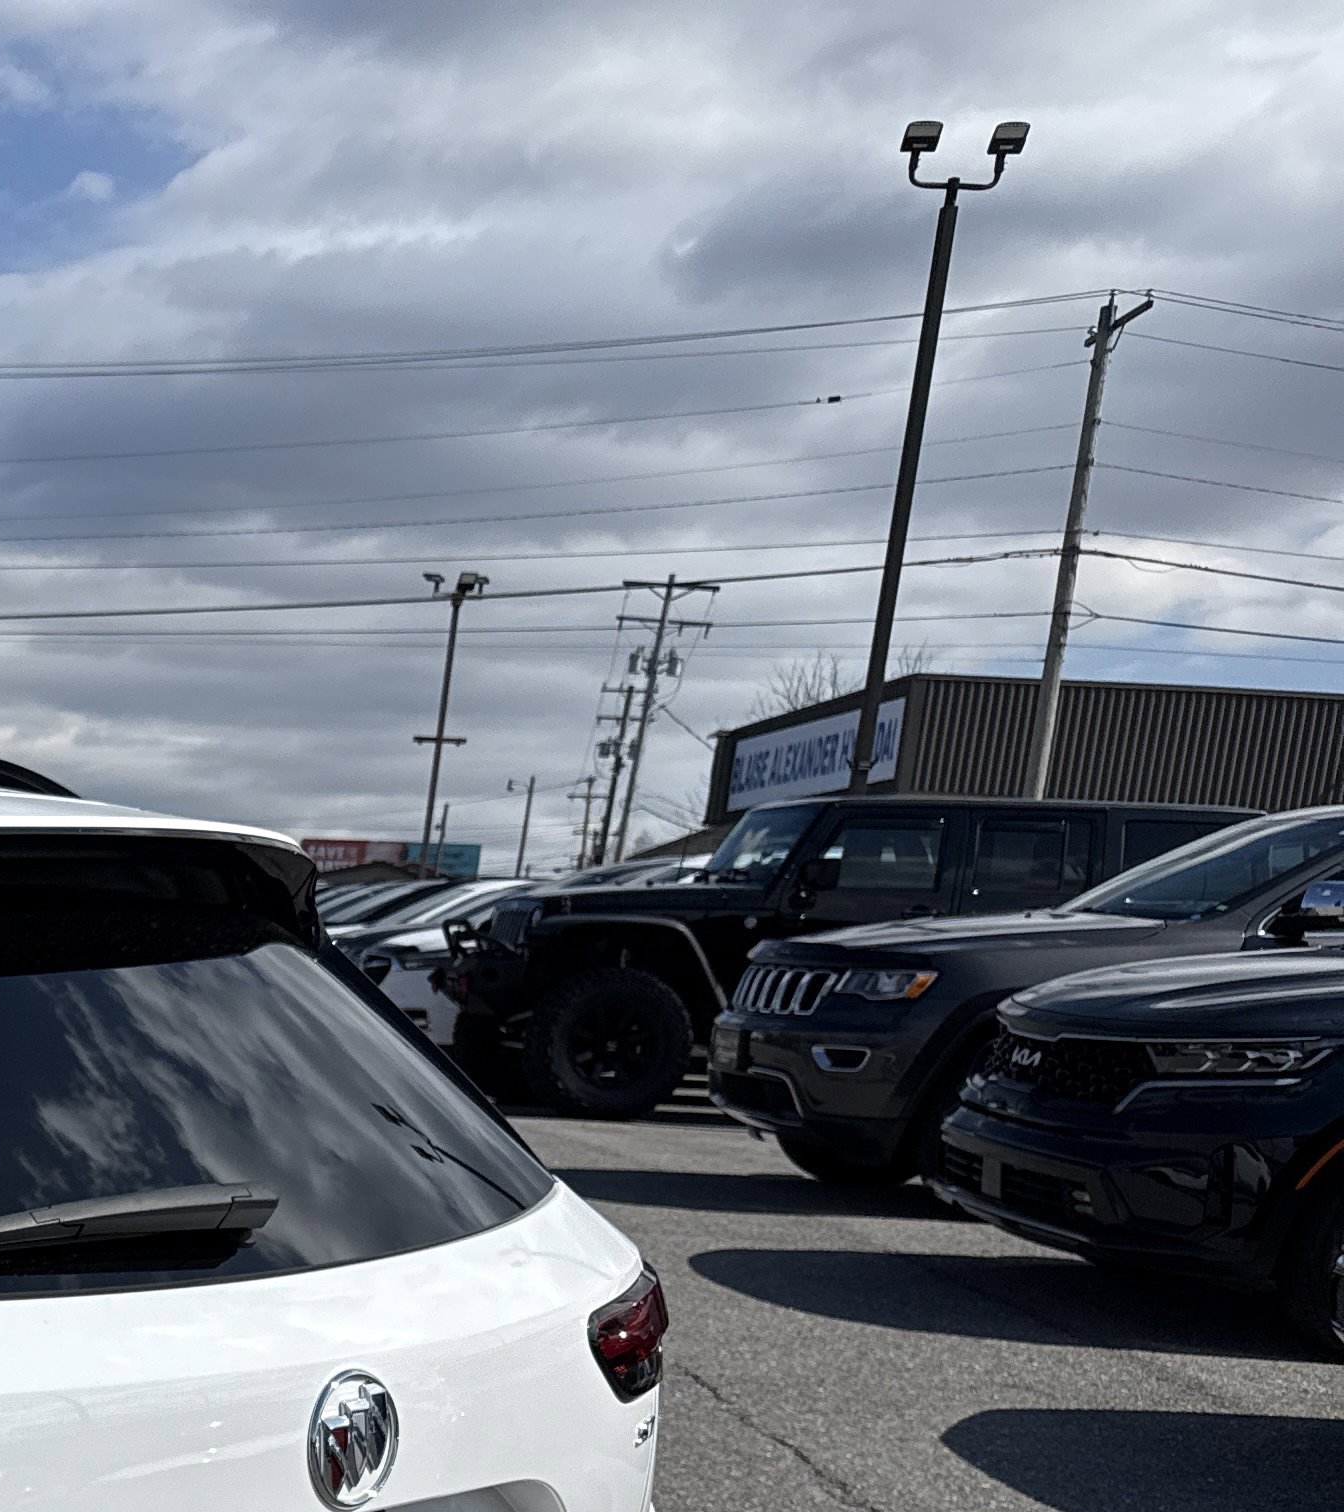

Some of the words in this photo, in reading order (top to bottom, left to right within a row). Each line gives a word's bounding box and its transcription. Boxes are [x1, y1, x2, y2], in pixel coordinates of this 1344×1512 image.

[731, 751, 771, 794] BLAISE
[768, 731, 840, 787] ALEXANDER
[838, 717, 899, 772] HDAI
